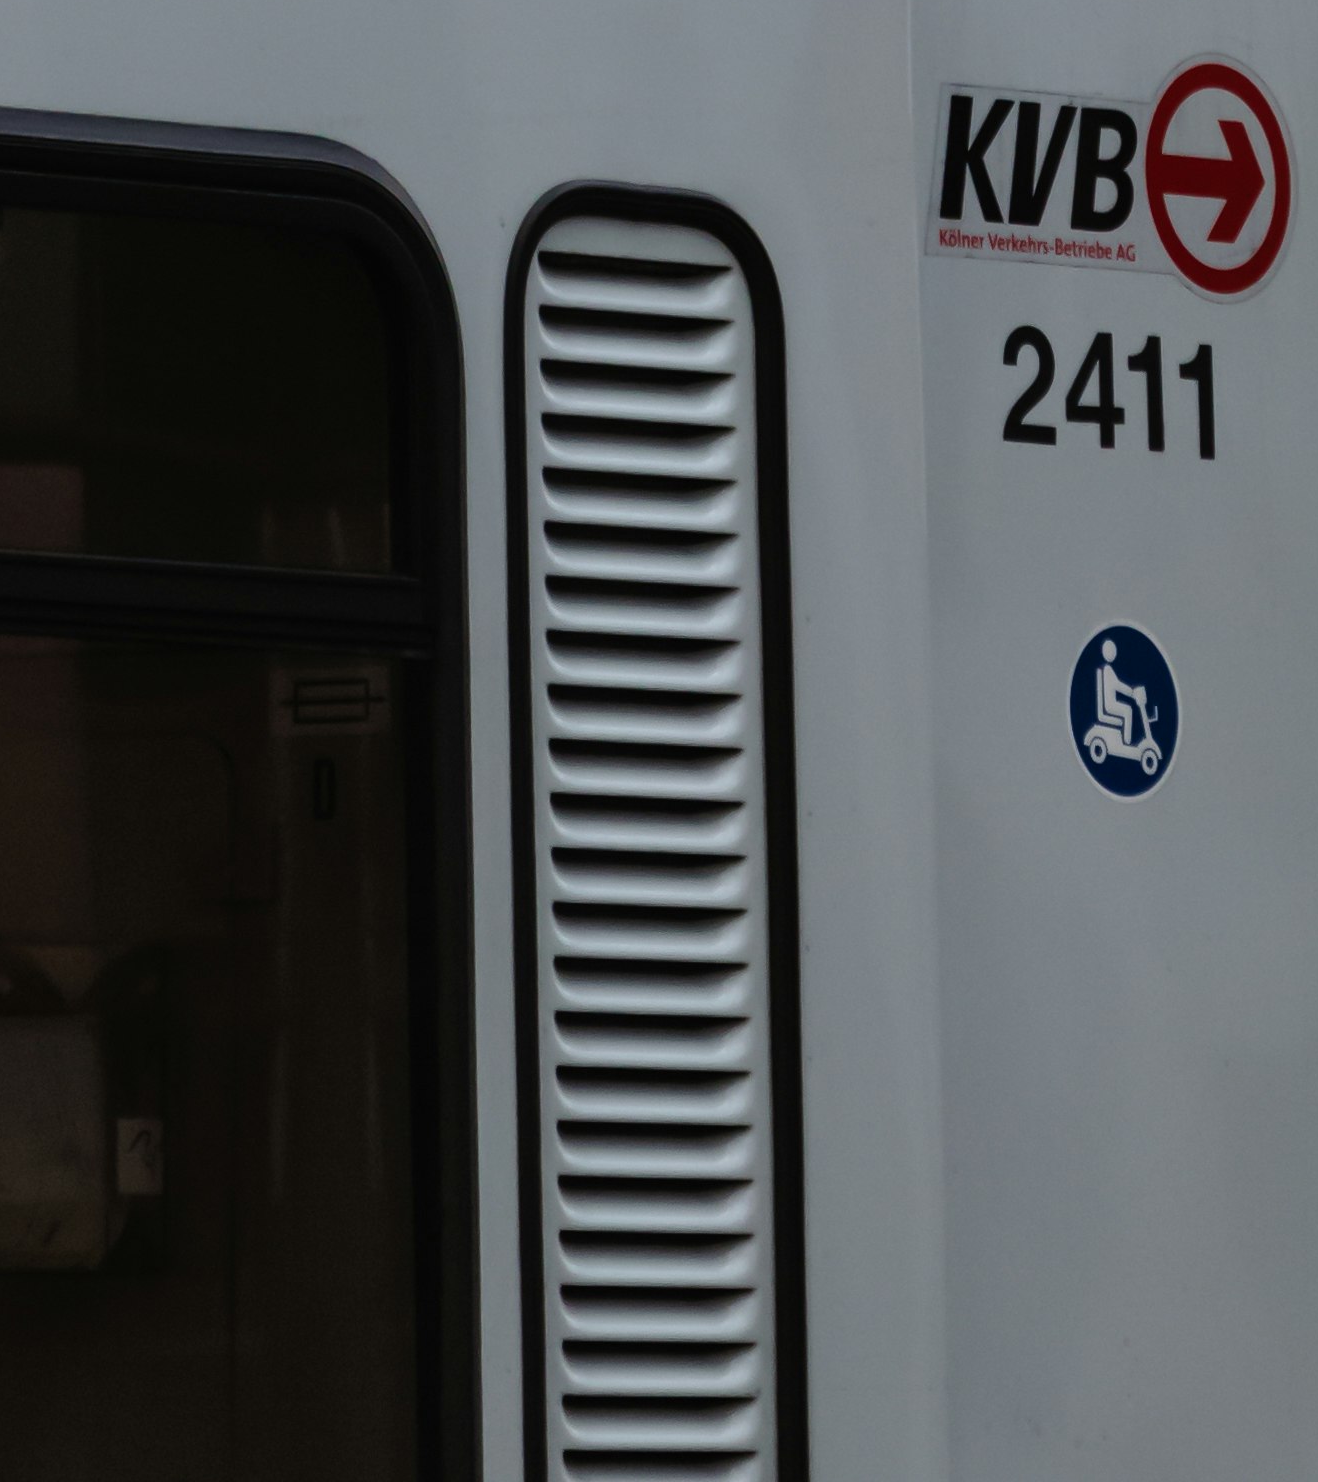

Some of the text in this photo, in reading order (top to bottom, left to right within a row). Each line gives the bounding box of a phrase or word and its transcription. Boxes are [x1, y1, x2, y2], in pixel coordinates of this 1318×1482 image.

[939, 94, 1138, 232] KVB
[939, 229, 1137, 262] Kölner Verkehrs-Betriebe AG
[1002, 325, 1216, 460] 2411
